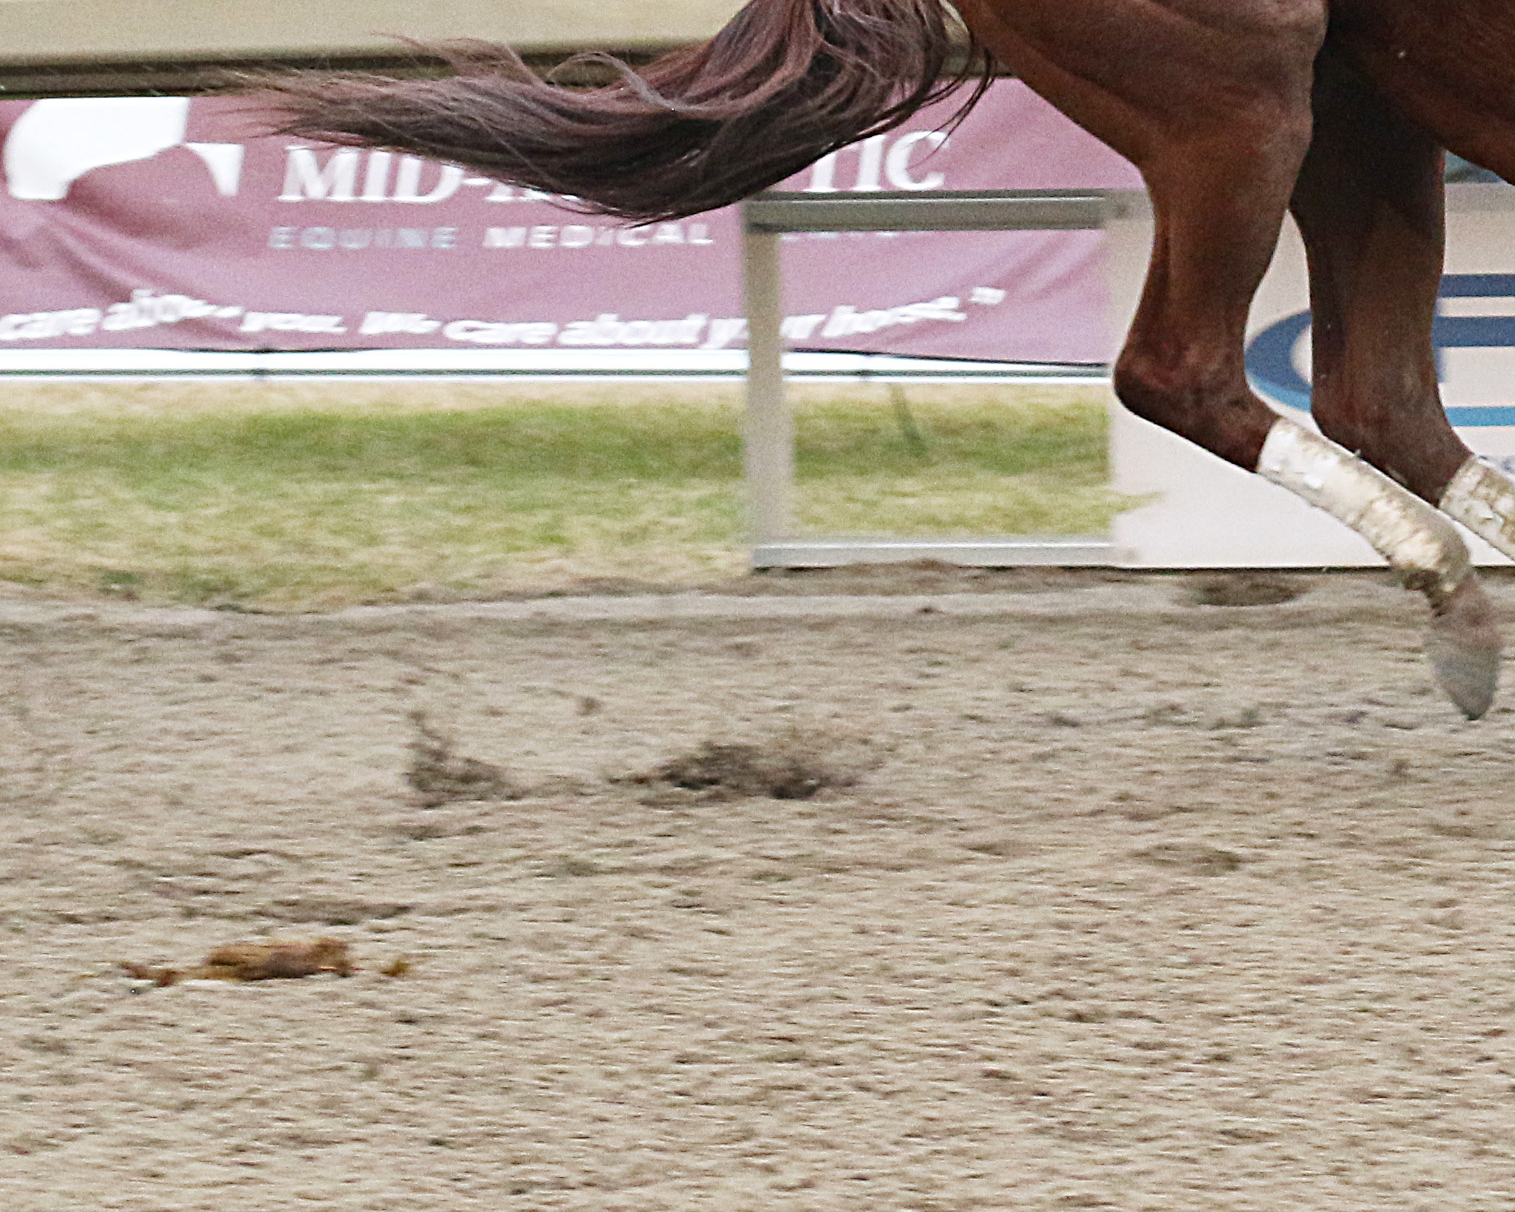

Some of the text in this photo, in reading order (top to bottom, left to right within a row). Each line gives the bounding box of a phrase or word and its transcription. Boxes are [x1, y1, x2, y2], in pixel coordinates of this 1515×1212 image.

[267, 223, 714, 251] EQUINE MEDICAL
[443, 319, 559, 344] care
[557, 312, 710, 346] about
